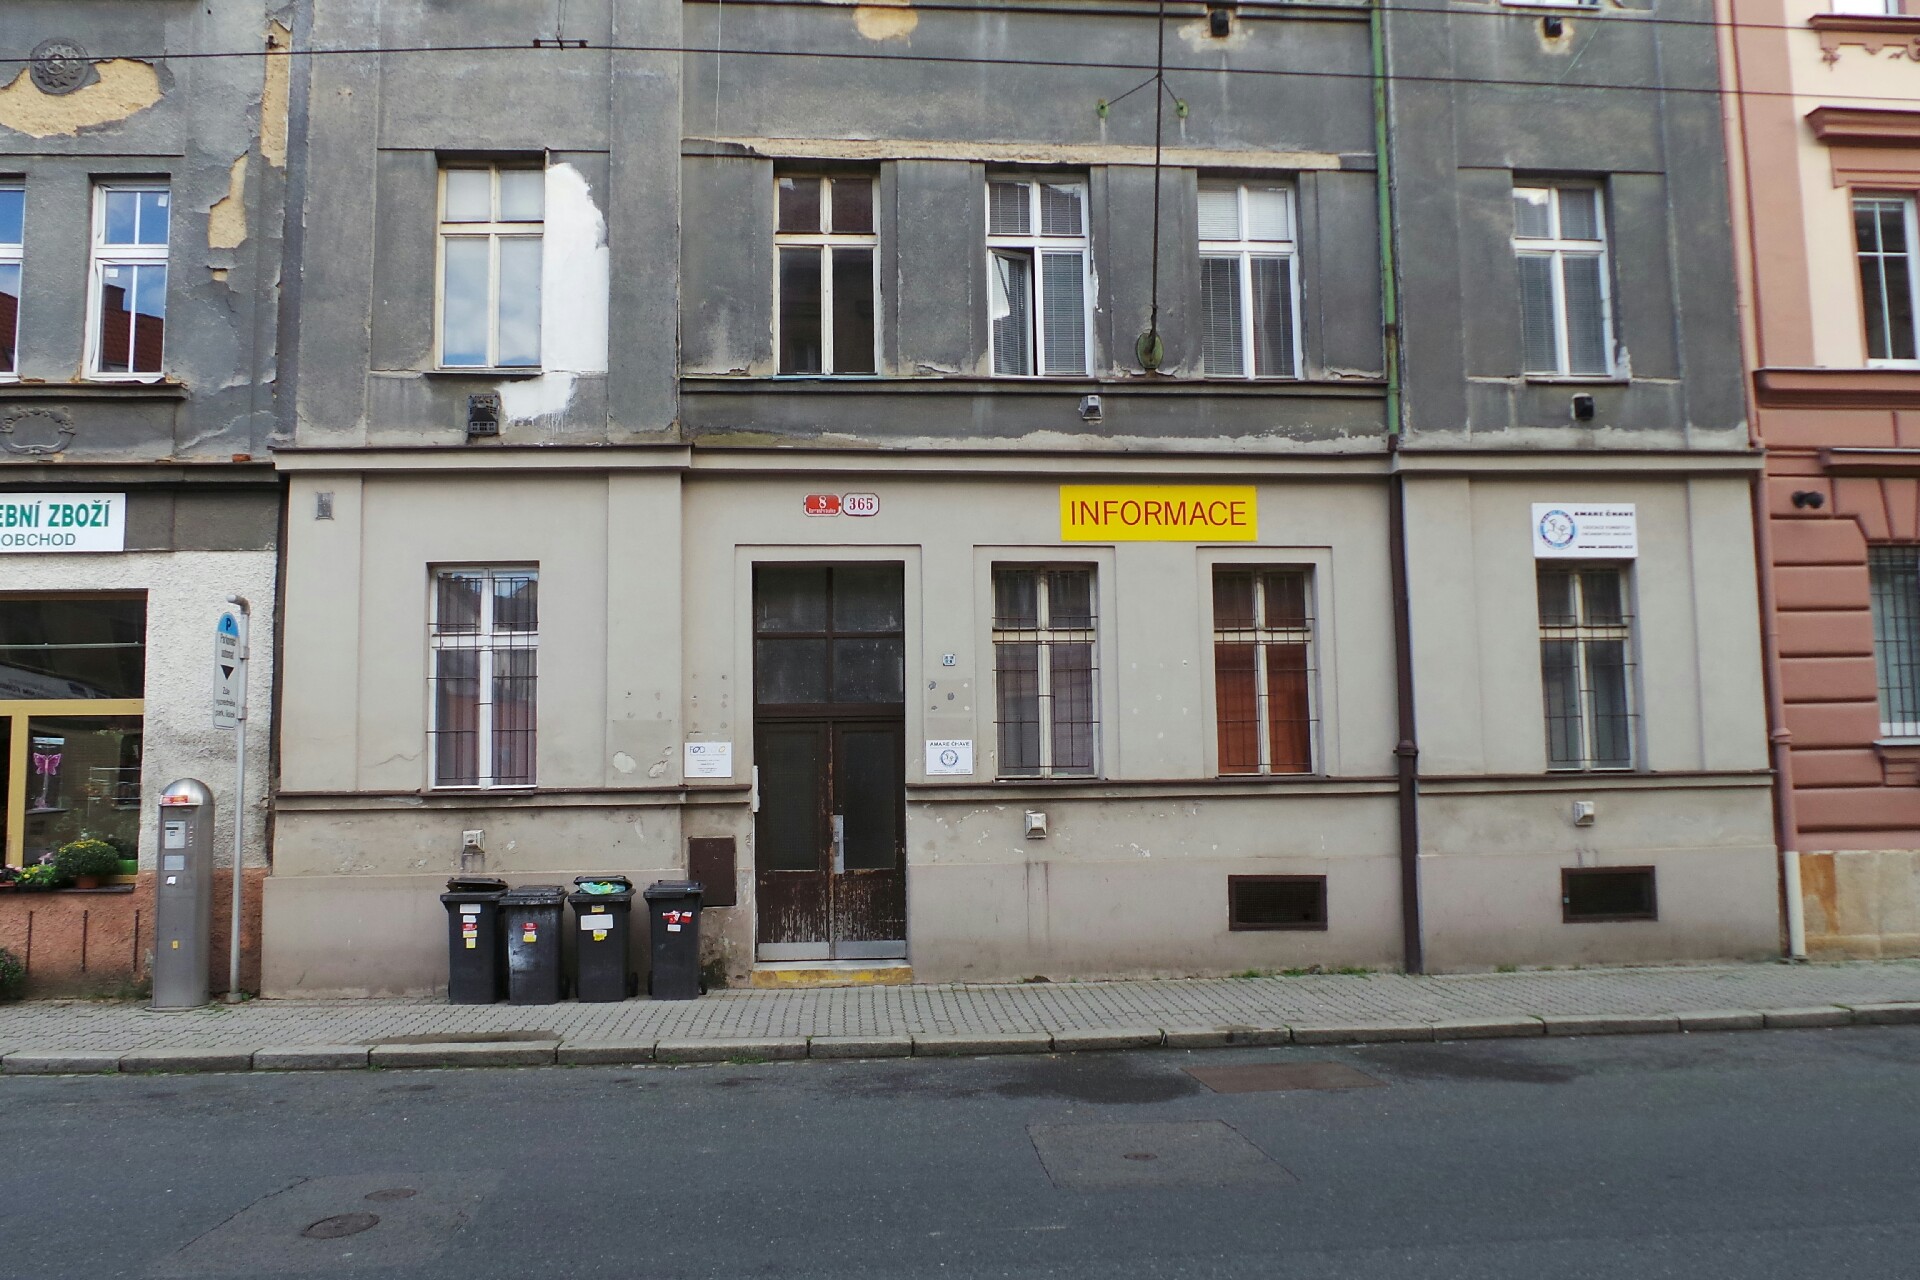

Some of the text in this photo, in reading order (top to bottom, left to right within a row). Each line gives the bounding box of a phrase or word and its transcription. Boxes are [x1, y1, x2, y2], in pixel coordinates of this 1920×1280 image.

[819, 496, 827, 509] 8
[849, 497, 873, 510] 365
[48, 500, 111, 527] ZBOŽÍ
[1071, 500, 1247, 526] INFORMACE
[1, 533, 76, 546] OBCHOD
[226, 617, 232, 631] P
